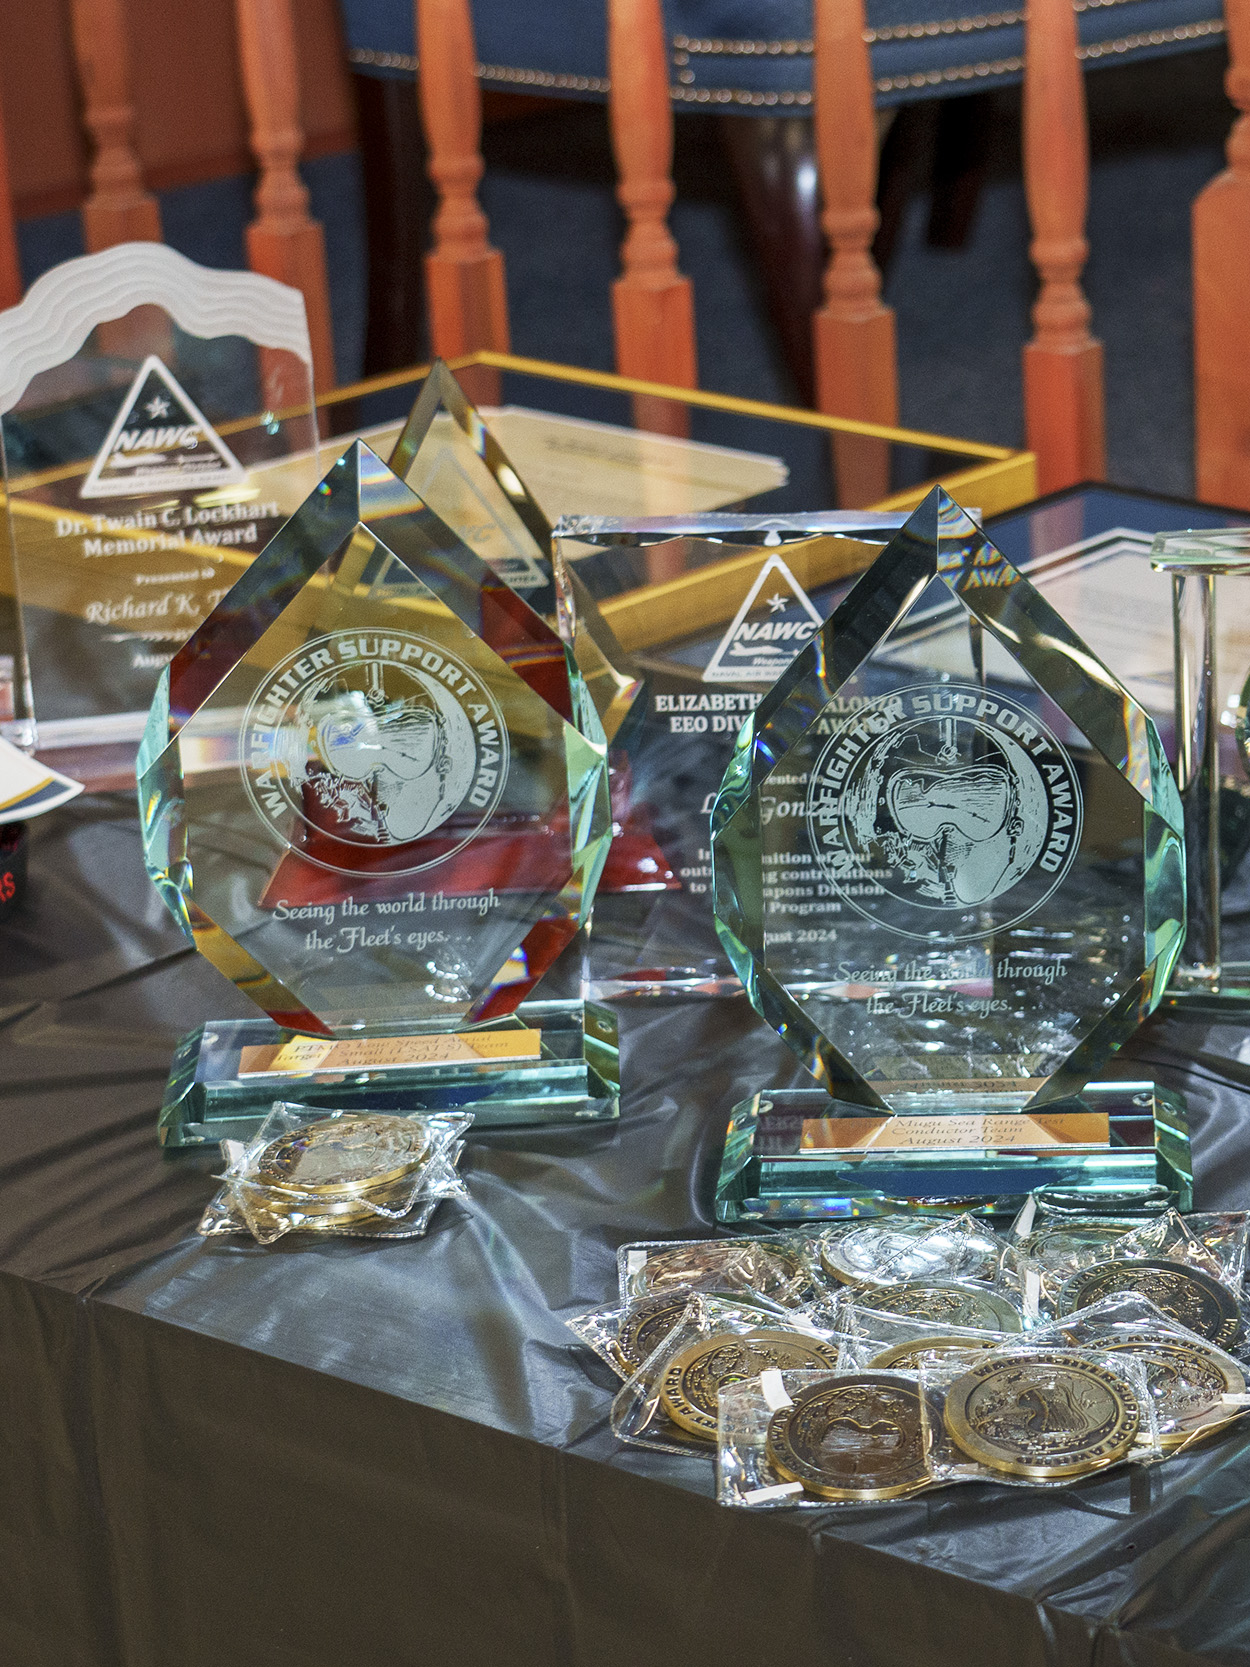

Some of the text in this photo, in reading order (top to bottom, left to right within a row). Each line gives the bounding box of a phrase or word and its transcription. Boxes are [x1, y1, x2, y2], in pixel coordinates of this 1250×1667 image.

[112, 425, 203, 451] NAWC
[56, 501, 280, 537] Dr. Twain C. Lockhart
[83, 524, 258, 558] Memorial Award
[85, 593, 171, 626] Richard
[175, 593, 201, 617] K.
[733, 621, 818, 641] NAWC
[250, 637, 501, 819] WARFIGHTER SUPPORT AWARD
[670, 716, 708, 734] EEO
[819, 693, 1074, 878] WARFIGHTER SUPPORT AWARD
[272, 888, 501, 926] Seeing the world through
[769, 901, 842, 916] Program
[305, 929, 334, 951] the
[336, 925, 402, 954] Fleet's
[797, 929, 838, 943] 2024
[833, 957, 1068, 989] Seeing the world through
[866, 997, 895, 1015] the
[899, 991, 966, 1020] Fleet's
[395, 1036, 440, 1050] Speed
[336, 1052, 451, 1067] August 2024
[891, 1125, 1024, 1136] Conductor Team
[897, 1118, 945, 1130] Mugu
[947, 1117, 981, 1127] Sea
[983, 1115, 1031, 1128] Range
[898, 1134, 1016, 1147] August 2024
